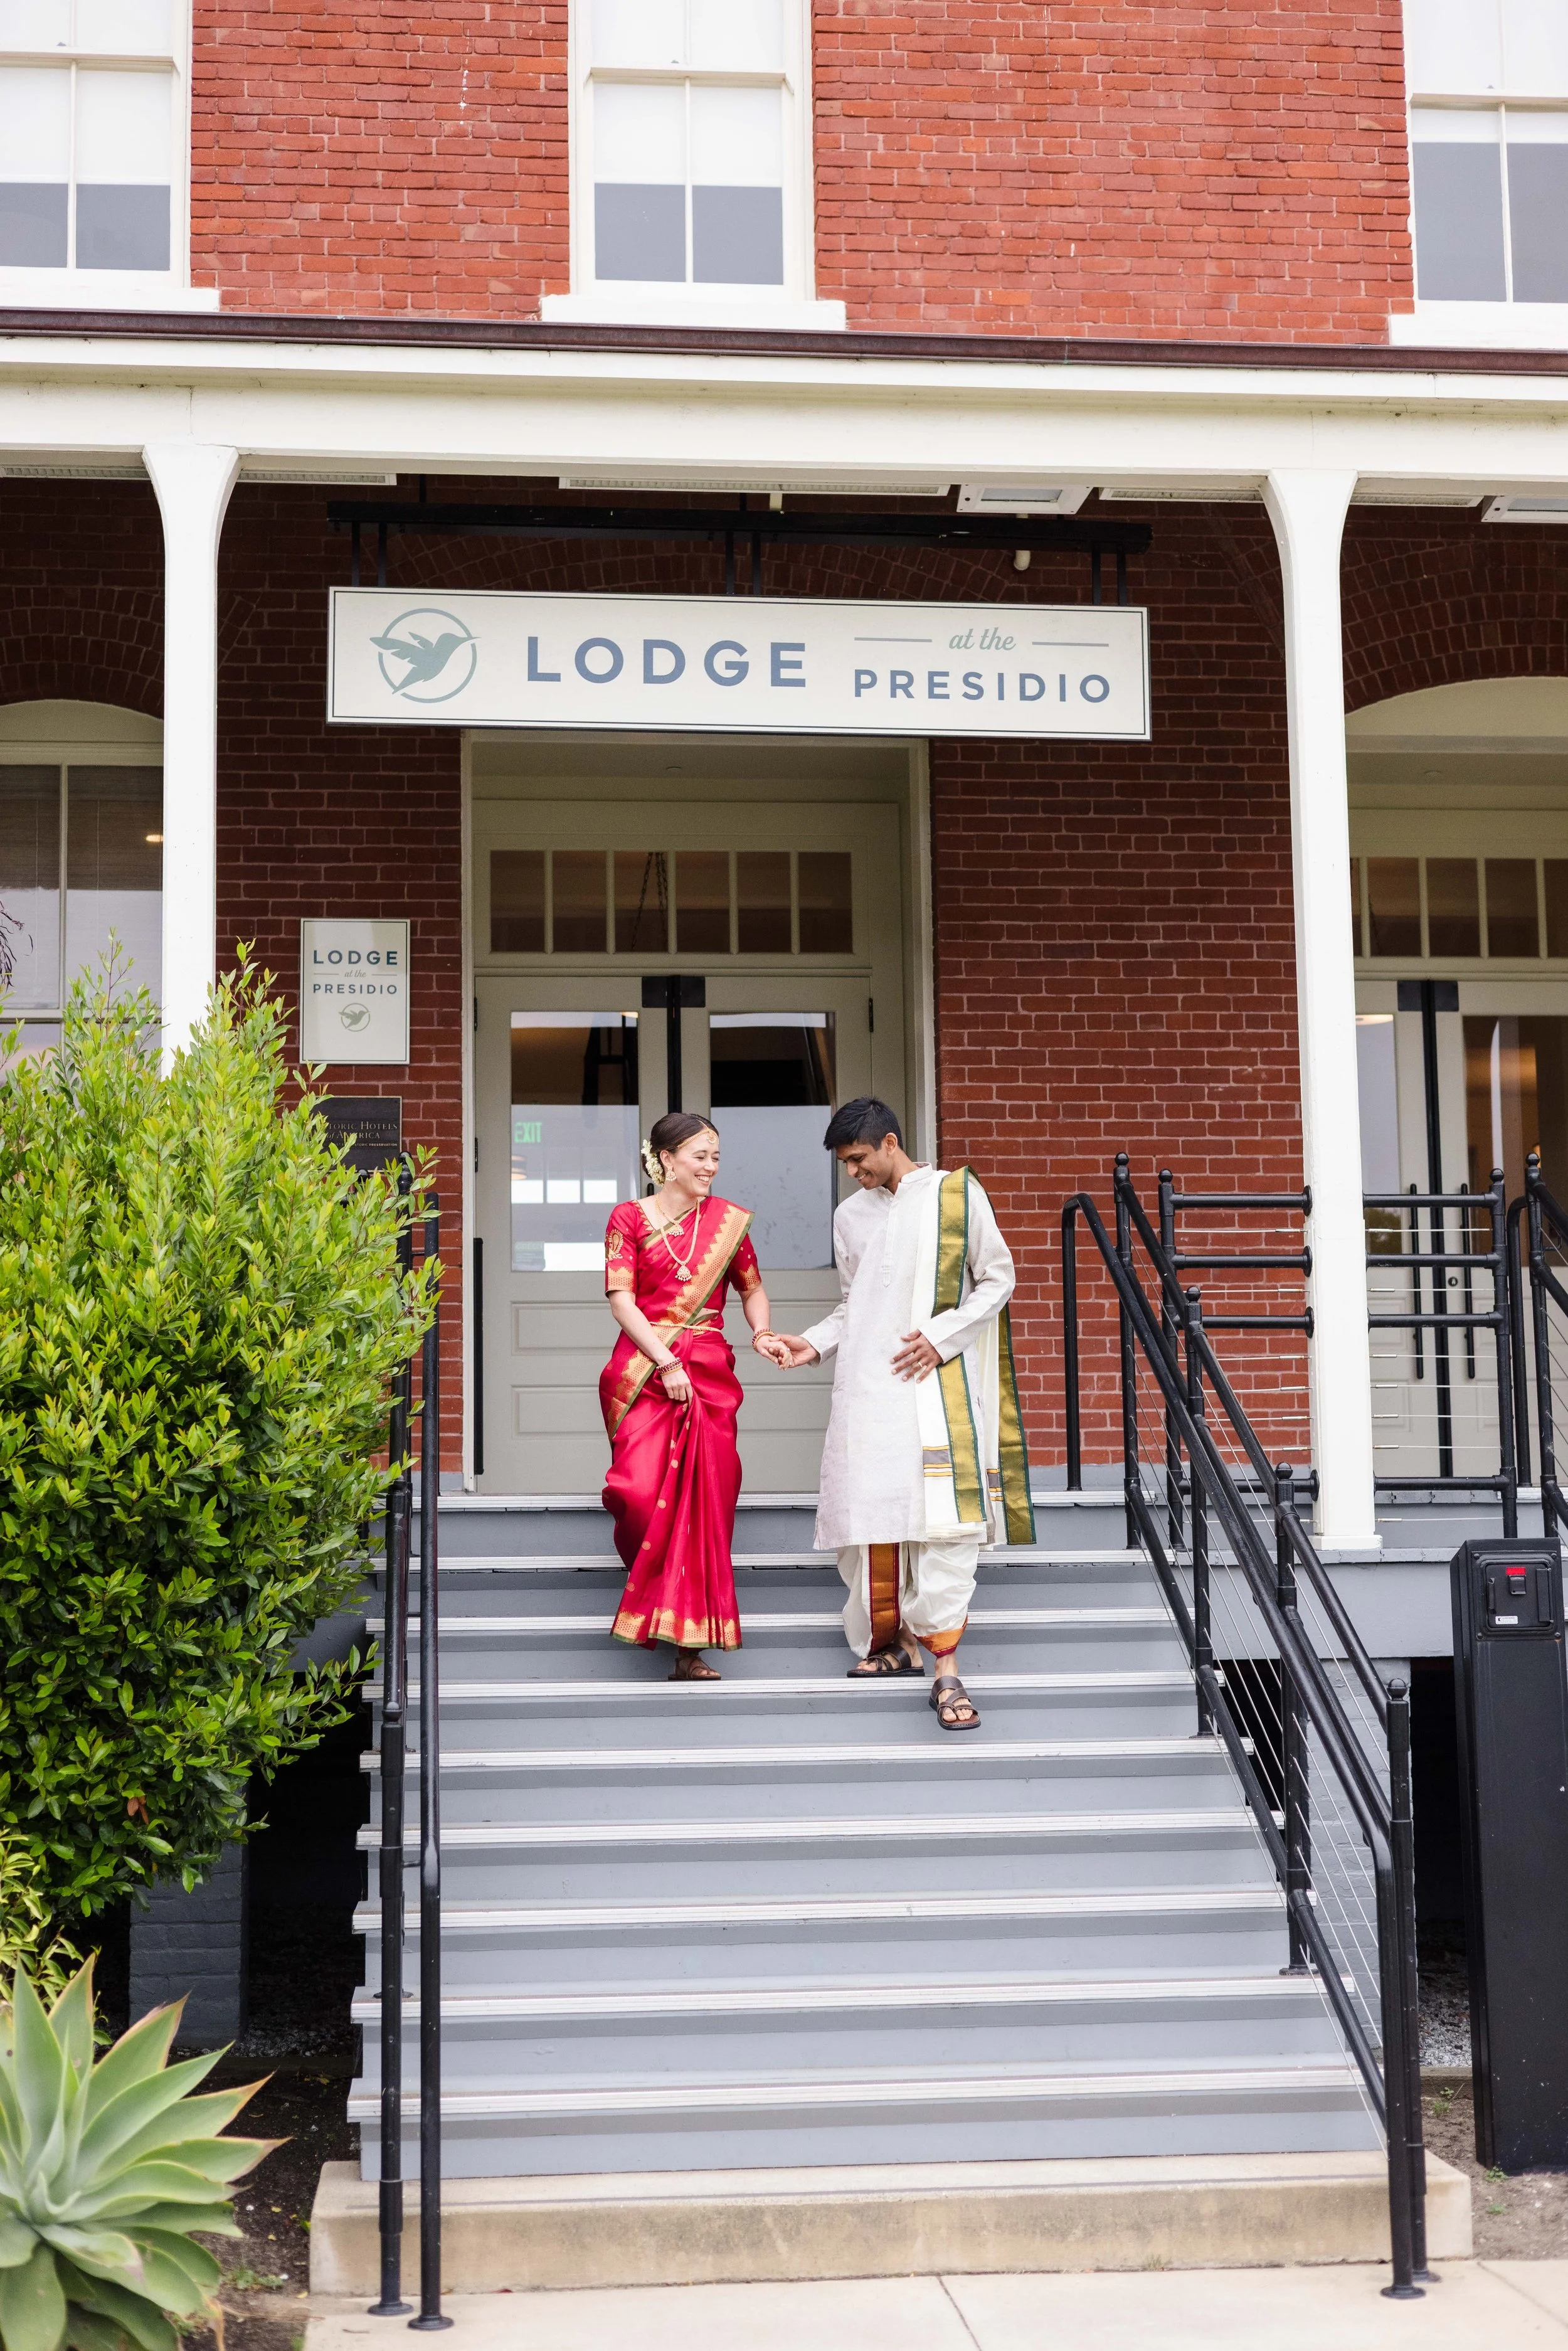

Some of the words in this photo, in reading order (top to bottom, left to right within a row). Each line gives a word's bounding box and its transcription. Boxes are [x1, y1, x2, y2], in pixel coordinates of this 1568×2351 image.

[949, 629, 975, 649] at
[979, 627, 1016, 650] the
[527, 636, 806, 687] LODGE
[854, 669, 1110, 703] PRESIDIO
[314, 950, 398, 965] LODGE
[354, 969, 367, 978] the
[314, 984, 397, 994] PRESIDIO
[327, 1132, 336, 1140] of
[514, 1122, 542, 1142] EXIT
